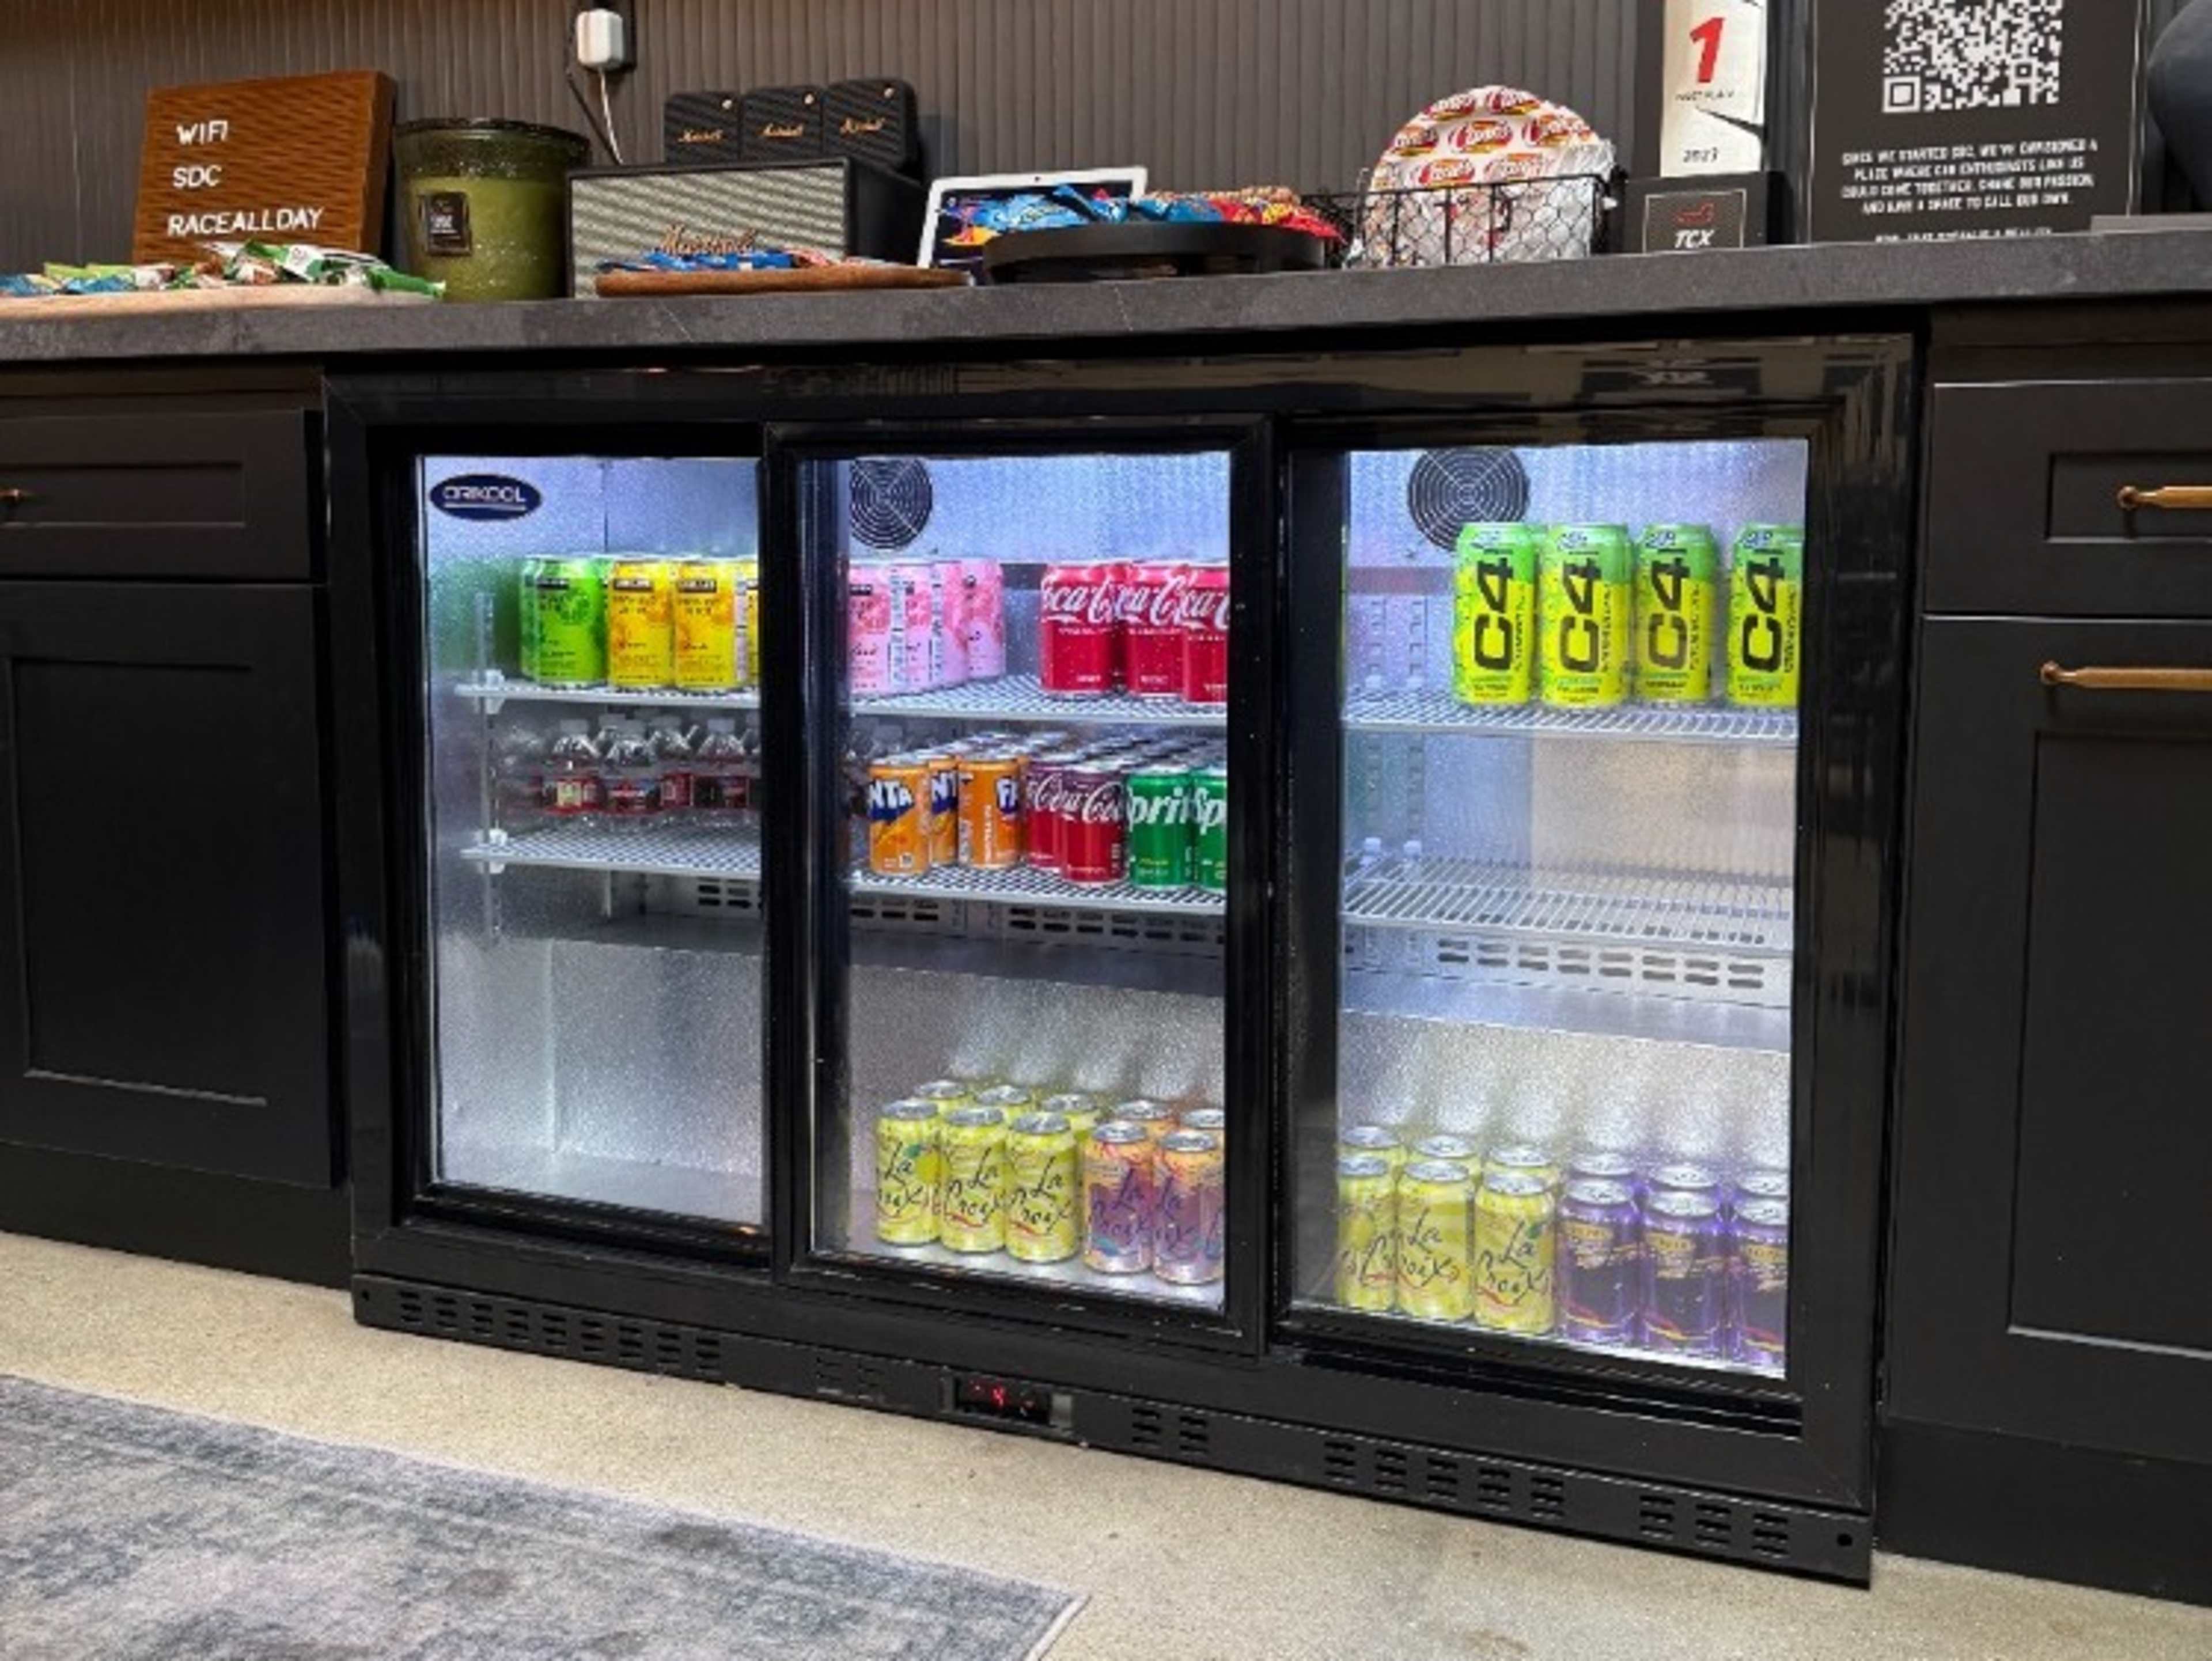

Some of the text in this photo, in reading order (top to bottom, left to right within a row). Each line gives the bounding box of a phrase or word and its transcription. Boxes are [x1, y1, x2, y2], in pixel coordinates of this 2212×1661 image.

[1690, 17, 1724, 82] 1
[173, 165, 222, 188] SDC
[176, 120, 228, 146] WIFI
[1675, 229, 1715, 249] TCX
[1474, 557, 1514, 671] C4
[1560, 557, 1601, 673] C4
[1648, 557, 1690, 670] C4
[1742, 557, 1785, 673] C4
